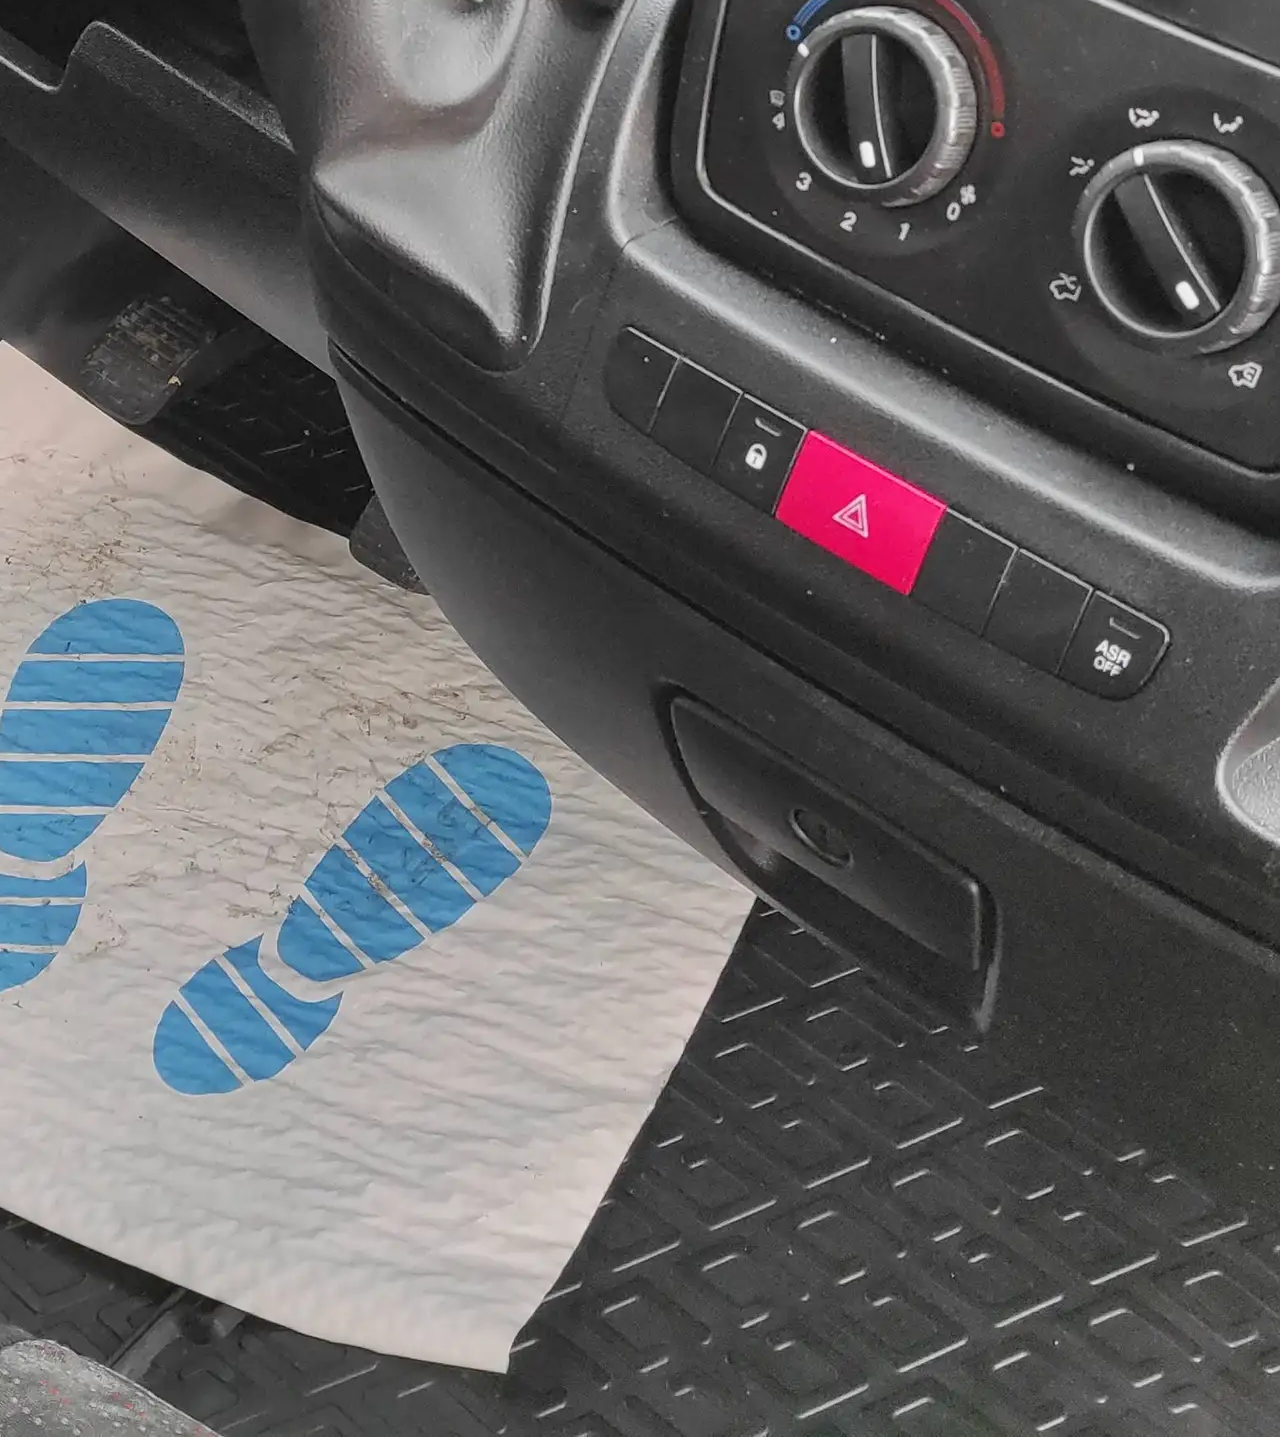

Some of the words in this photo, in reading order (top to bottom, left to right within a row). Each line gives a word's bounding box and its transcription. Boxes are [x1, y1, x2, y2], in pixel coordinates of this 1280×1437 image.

[772, 111, 786, 131] 4
[795, 171, 812, 191] 3
[839, 211, 858, 232] 2
[946, 202, 961, 221] 0
[898, 222, 911, 242] 1
[1095, 639, 1132, 669] ASR
[1093, 655, 1122, 677] OFF
